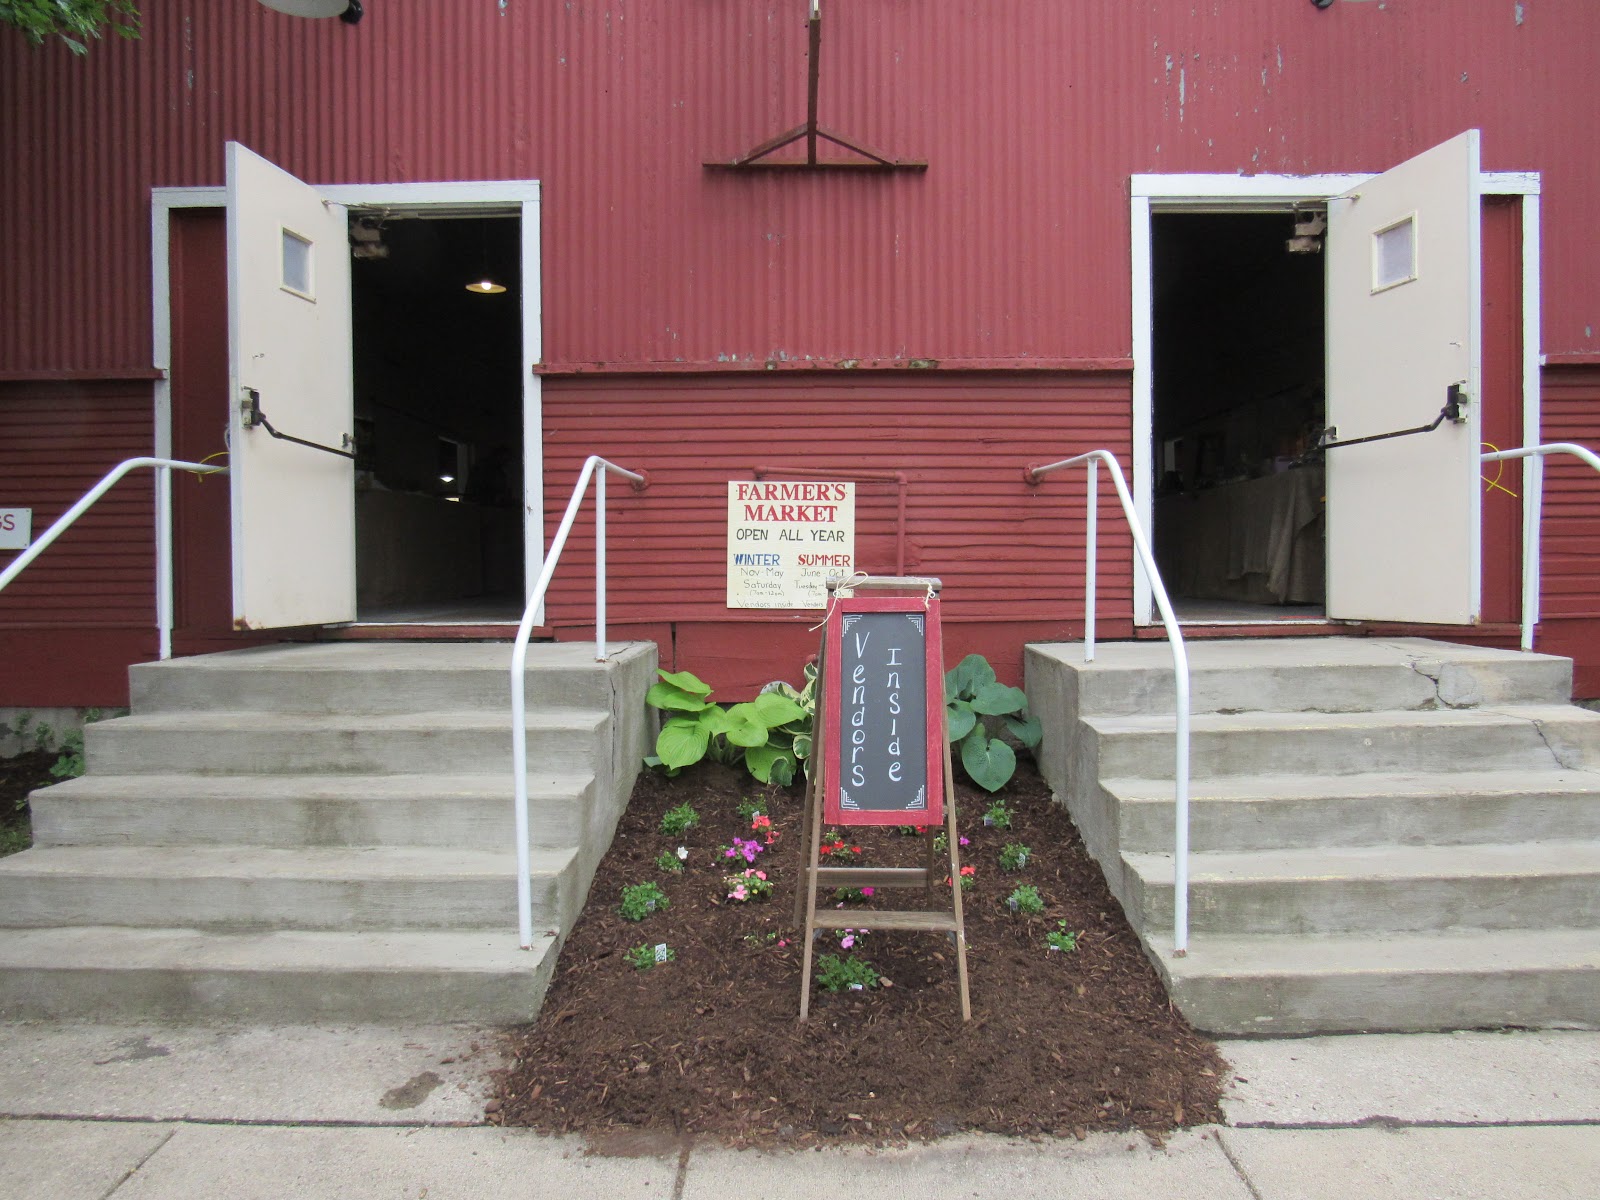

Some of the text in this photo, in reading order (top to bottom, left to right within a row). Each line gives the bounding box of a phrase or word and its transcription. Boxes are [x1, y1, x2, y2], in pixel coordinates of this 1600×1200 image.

[737, 483, 846, 501] FARMER'S
[744, 504, 838, 522] MARKET
[736, 528, 845, 542] OPEN ALL YEAR
[733, 553, 781, 566] WINTER
[797, 554, 850, 567] SUMMER
[743, 579, 782, 590] Saturday
[736, 600, 771, 608] Vendors
[852, 632, 870, 787] Vendors
